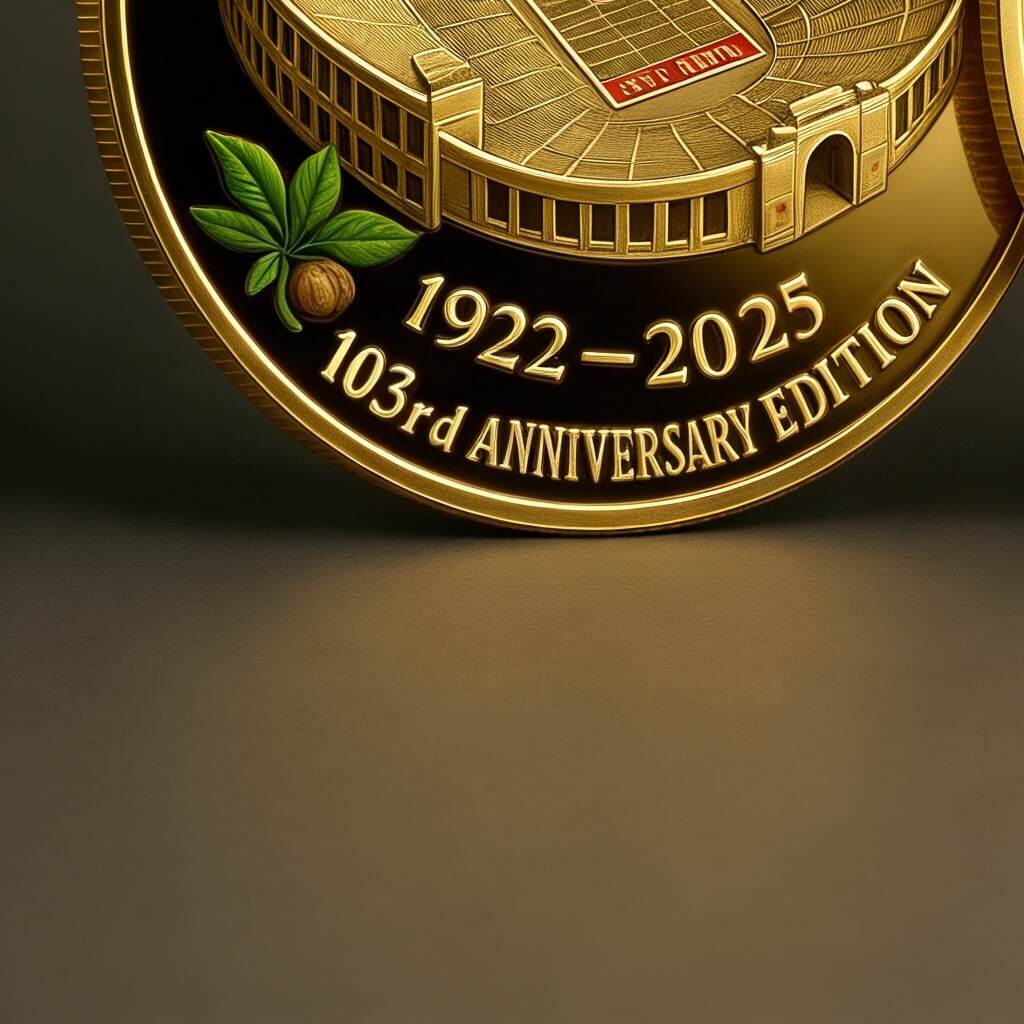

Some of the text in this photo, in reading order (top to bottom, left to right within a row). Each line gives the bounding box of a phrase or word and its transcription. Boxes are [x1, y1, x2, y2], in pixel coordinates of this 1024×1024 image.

[320, 259, 951, 483] 103rd ANNIVERSARY EDITION
